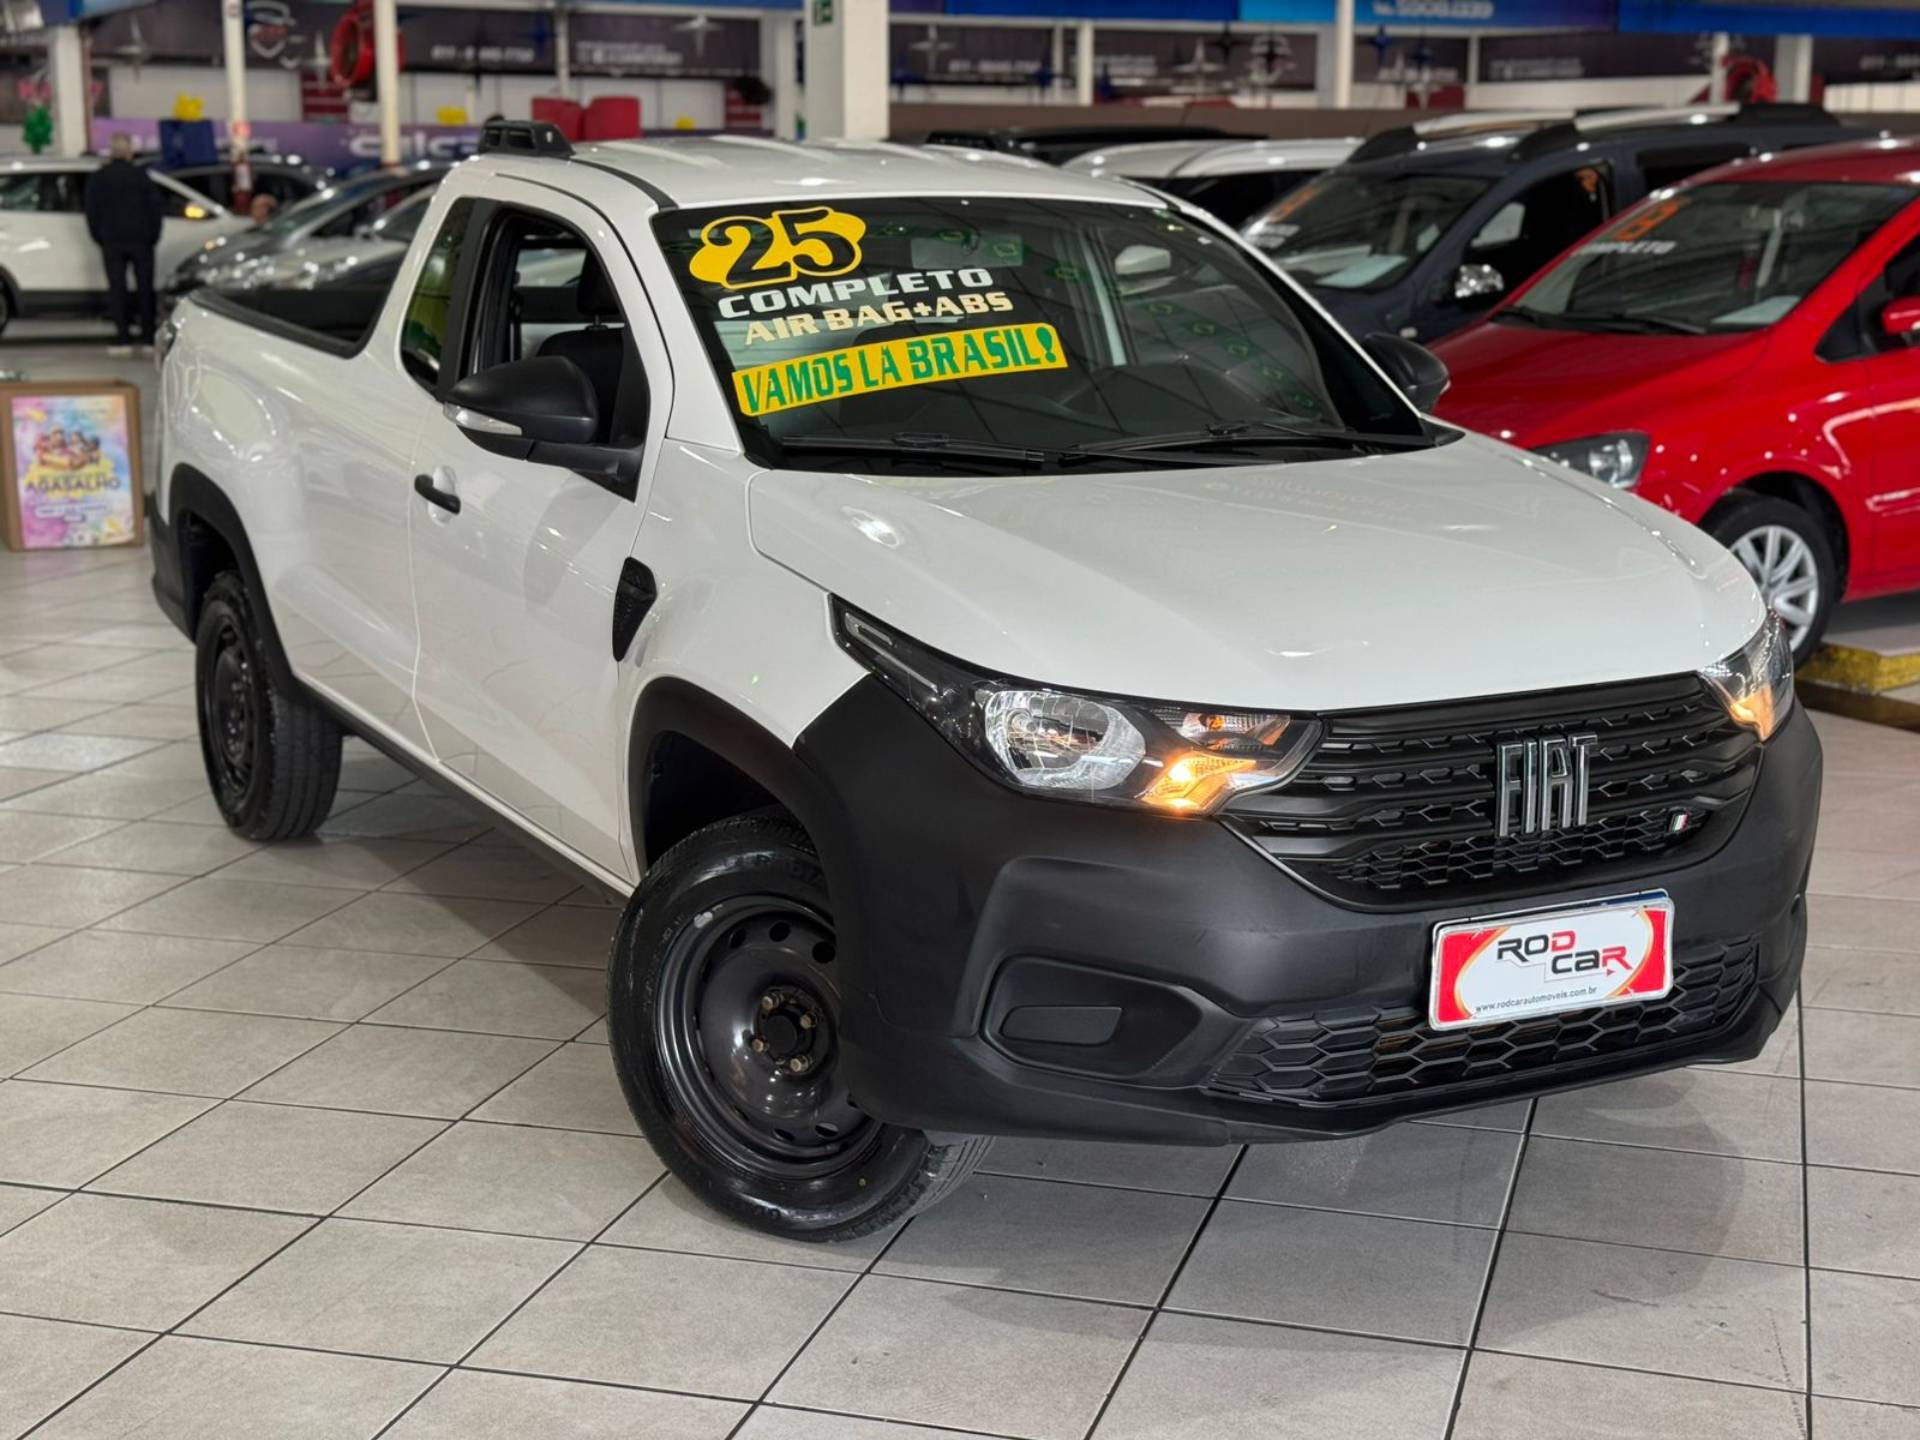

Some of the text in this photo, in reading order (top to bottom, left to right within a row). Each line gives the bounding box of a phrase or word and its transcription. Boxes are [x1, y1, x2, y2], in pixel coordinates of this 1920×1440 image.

[702, 207, 860, 287] 25
[717, 268, 993, 318] COMPLETO
[744, 291, 1014, 346] AIR BAG+ABS
[741, 326, 1057, 414] VAMOS LA BRASIL!
[1497, 734, 1598, 837] FIAT
[1497, 930, 1576, 963] ROD
[1475, 985, 1598, 1013] www.rodcarautomoveis.com.br
